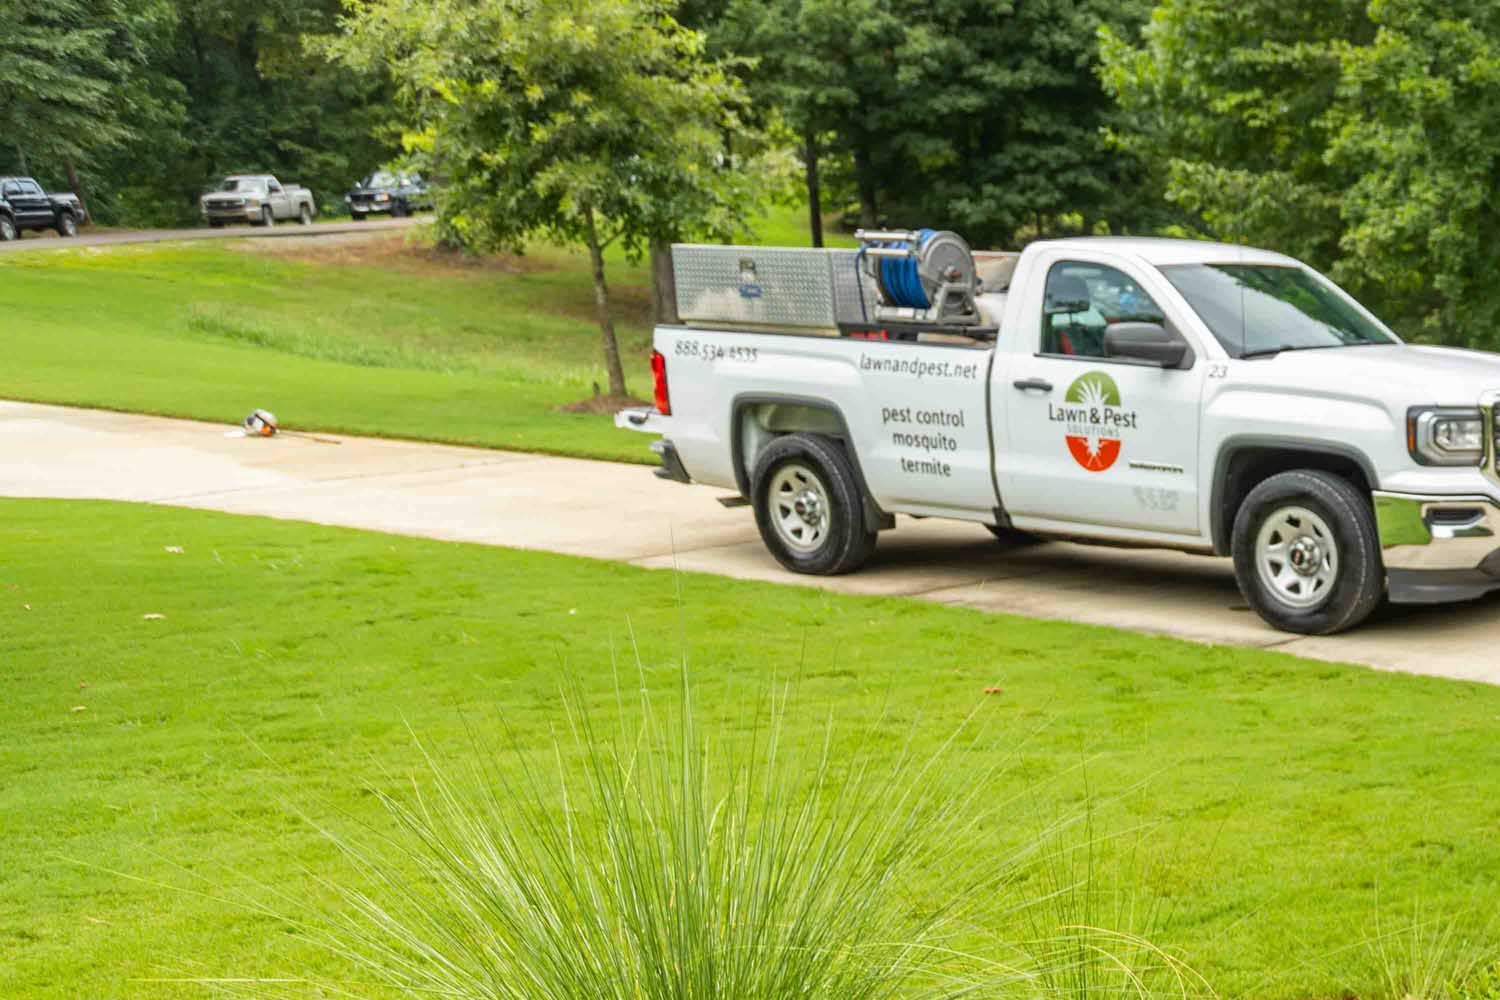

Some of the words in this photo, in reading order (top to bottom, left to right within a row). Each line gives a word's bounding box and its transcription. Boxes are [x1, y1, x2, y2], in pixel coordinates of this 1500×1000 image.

[859, 352, 977, 379] lawnandpest.net
[1208, 364, 1229, 378] 23
[882, 407, 912, 426] pest
[916, 408, 965, 428] control
[1048, 401, 1087, 422] Lawn
[1089, 406, 1101, 424] &
[1103, 406, 1137, 429] Pest
[893, 432, 957, 453] mosquito
[901, 456, 952, 478] termite
